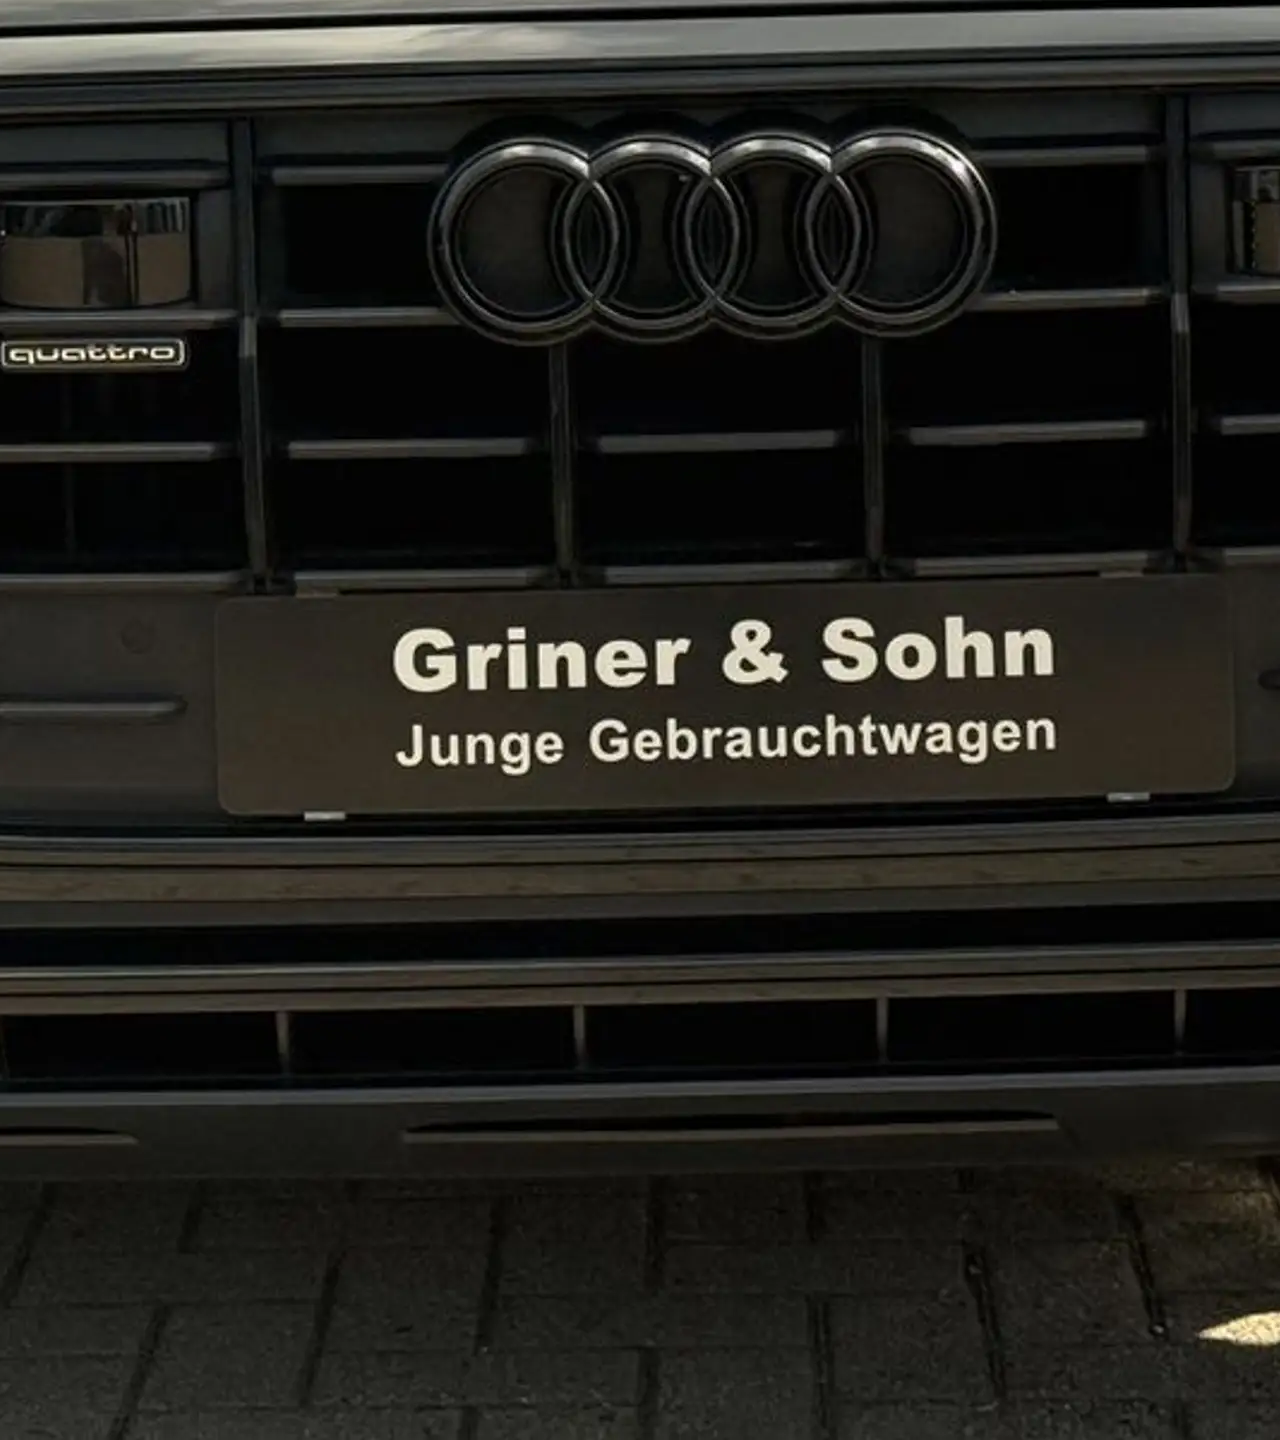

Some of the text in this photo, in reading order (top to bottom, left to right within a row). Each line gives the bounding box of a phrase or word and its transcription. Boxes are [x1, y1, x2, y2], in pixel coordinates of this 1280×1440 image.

[8, 343, 176, 365] quattro
[392, 614, 1055, 694] Griner & Sohn
[394, 712, 1057, 777] Junge Gebrauchtwagen
